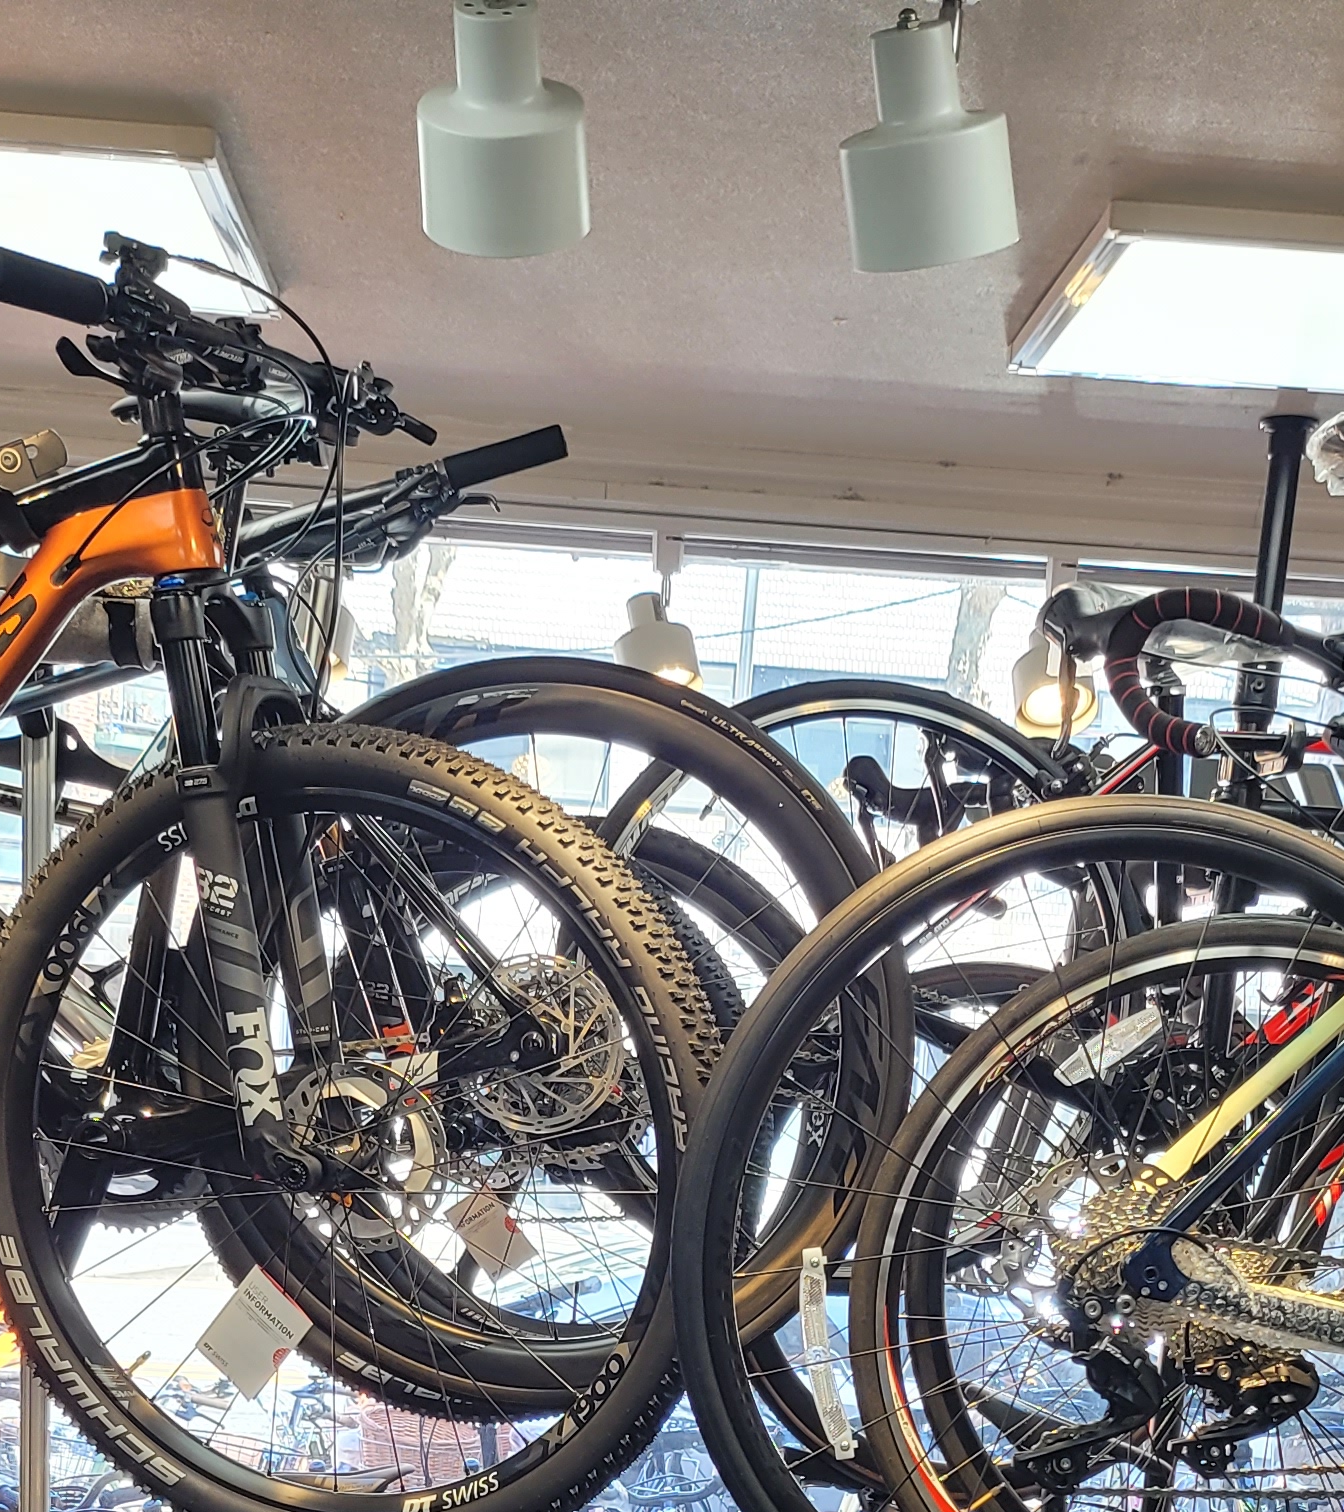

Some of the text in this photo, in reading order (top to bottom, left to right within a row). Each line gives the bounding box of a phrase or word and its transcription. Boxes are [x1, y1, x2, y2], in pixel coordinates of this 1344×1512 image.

[157, 820, 188, 853] ISS
[514, 837, 689, 1153] RACING RALPH
[225, 1006, 284, 1126] FOX
[460, 1201, 496, 1228] FORMATION
[247, 1280, 270, 1305] USER
[243, 1287, 295, 1341] INFORMATION
[442, 1471, 500, 1510] SWISS
